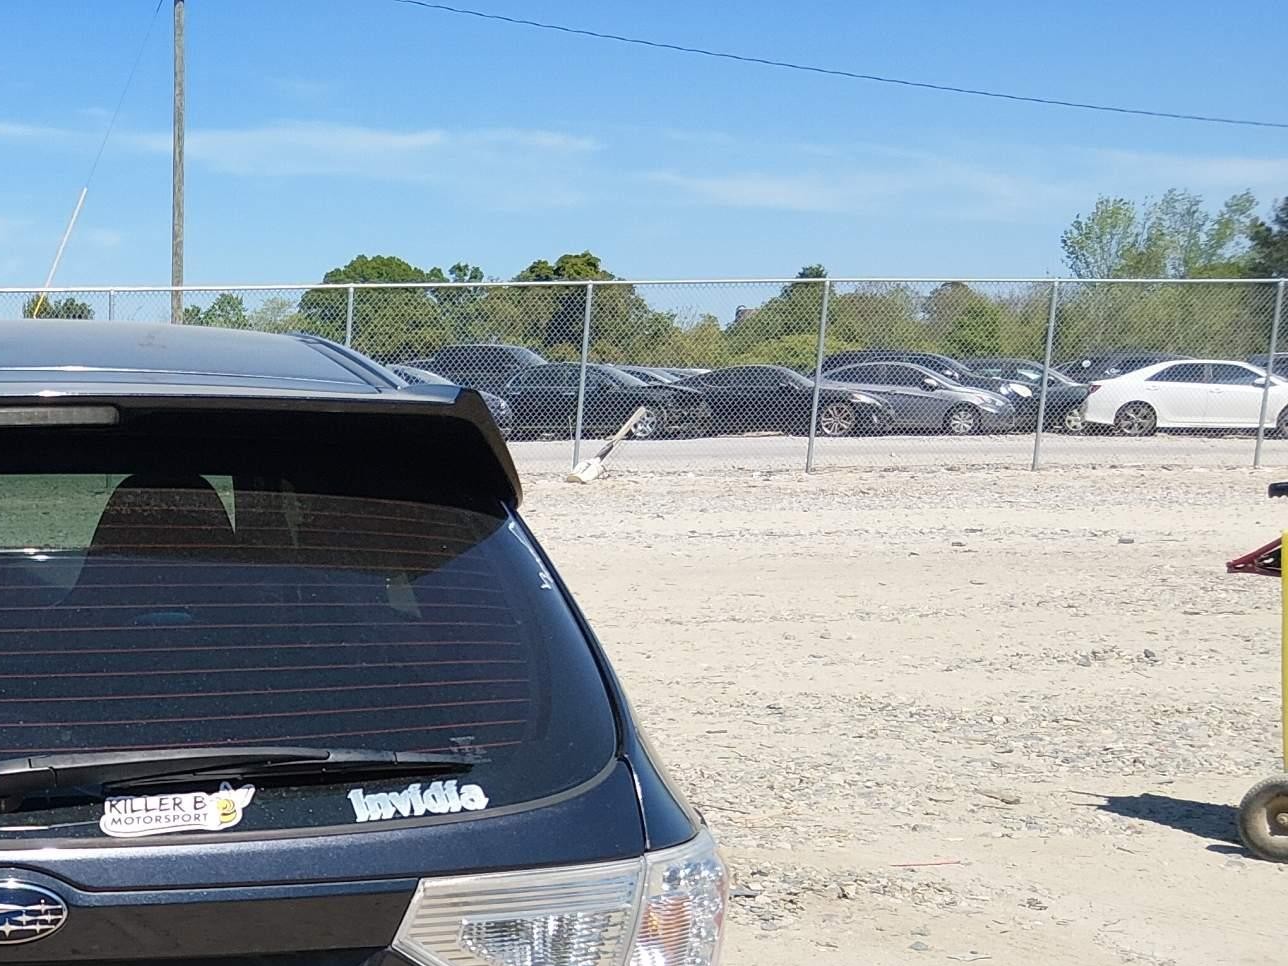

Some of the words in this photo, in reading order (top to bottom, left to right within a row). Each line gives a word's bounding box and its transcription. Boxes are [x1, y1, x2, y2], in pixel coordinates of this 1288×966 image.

[109, 796, 186, 814] KILLER
[193, 795, 208, 810] B
[347, 779, 489, 823] Invidia
[110, 812, 209, 826] MOTORSPORT
